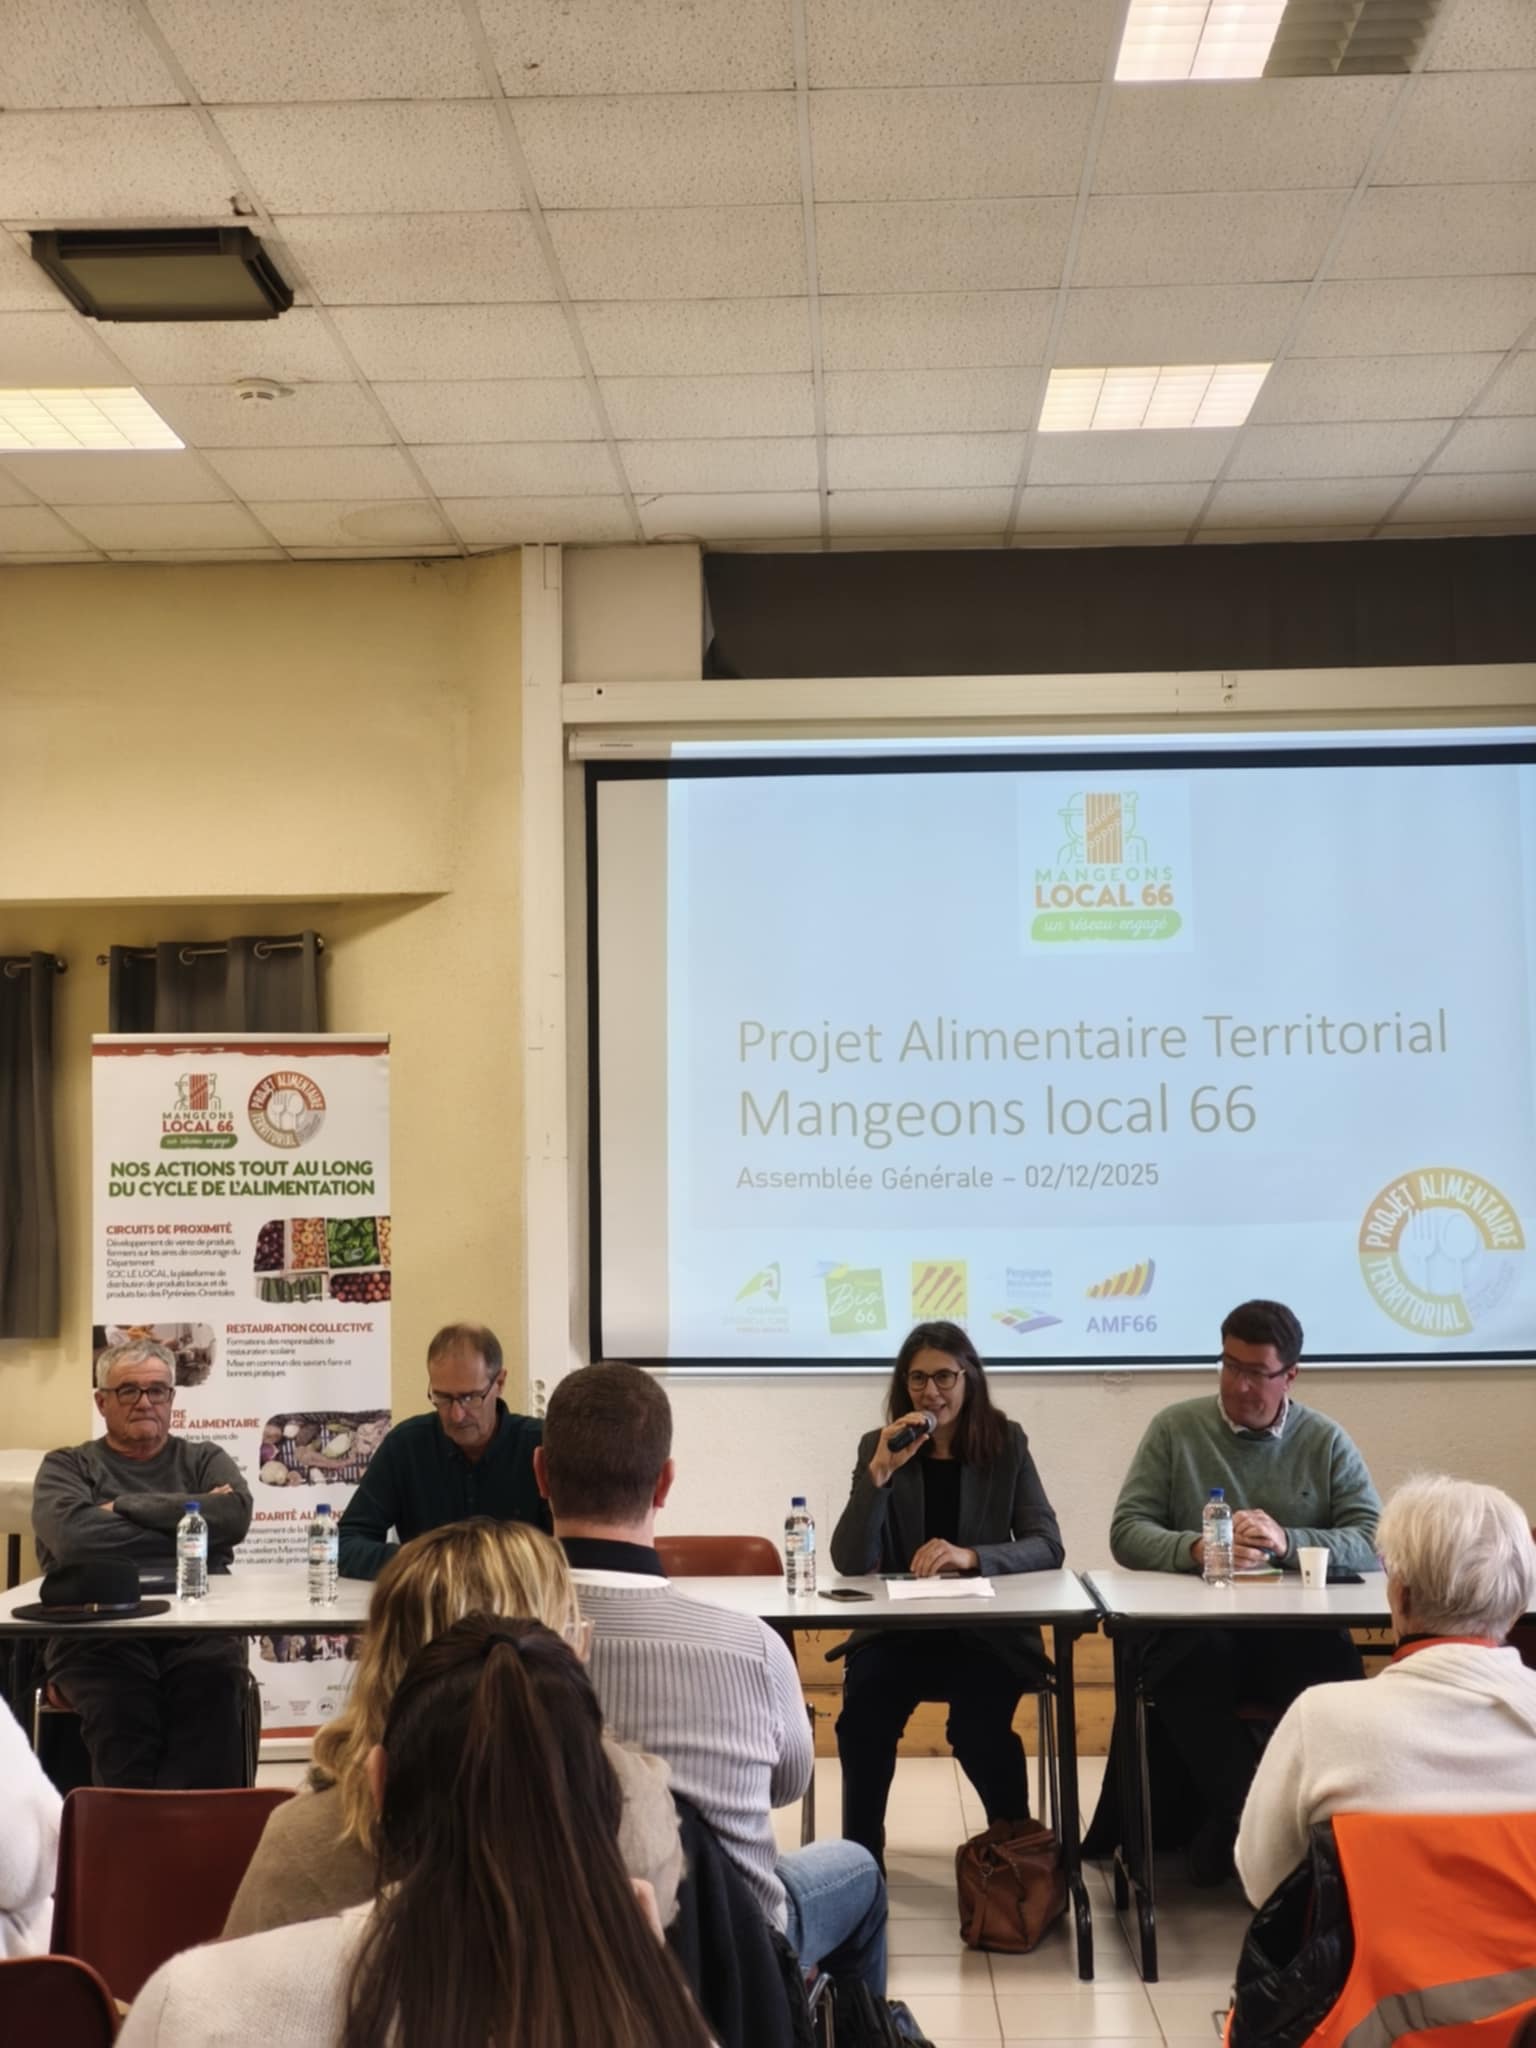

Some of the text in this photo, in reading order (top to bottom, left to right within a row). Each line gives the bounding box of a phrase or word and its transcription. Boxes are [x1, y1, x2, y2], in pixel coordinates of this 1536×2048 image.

[1035, 867, 1173, 882] MANGEONS
[1035, 882, 1174, 908] LOCAL 66
[739, 1007, 1447, 1073] Projet Alimentaire Territorial
[162, 1112, 234, 1120] MANGEONS
[740, 1082, 1257, 1150] Mangeons local 66
[162, 1120, 234, 1133] LOCAL 66
[111, 1160, 373, 1177] NOS ACTIONS TOUT AU LONG
[736, 1165, 872, 1190] Assemblée
[882, 1163, 993, 1188] Générale
[1025, 1161, 1159, 1190] 02/12/2025
[109, 1181, 135, 1197] DU
[139, 1181, 198, 1197] CYCLE
[201, 1180, 226, 1196] DE
[1365, 1173, 1518, 1248] PROJET ALIMENTAIRE
[106, 1221, 232, 1234] CIRCUITS DE PROXIMITÉ
[830, 1284, 880, 1317] Bio
[1368, 1257, 1465, 1329] TERRITORIAL
[854, 1309, 877, 1324] 66
[1086, 1314, 1158, 1334] AMF66
[226, 1322, 374, 1334] RESTAURATION COLLECTIVE
[188, 1418, 259, 1429] ALIMENTAIRE
